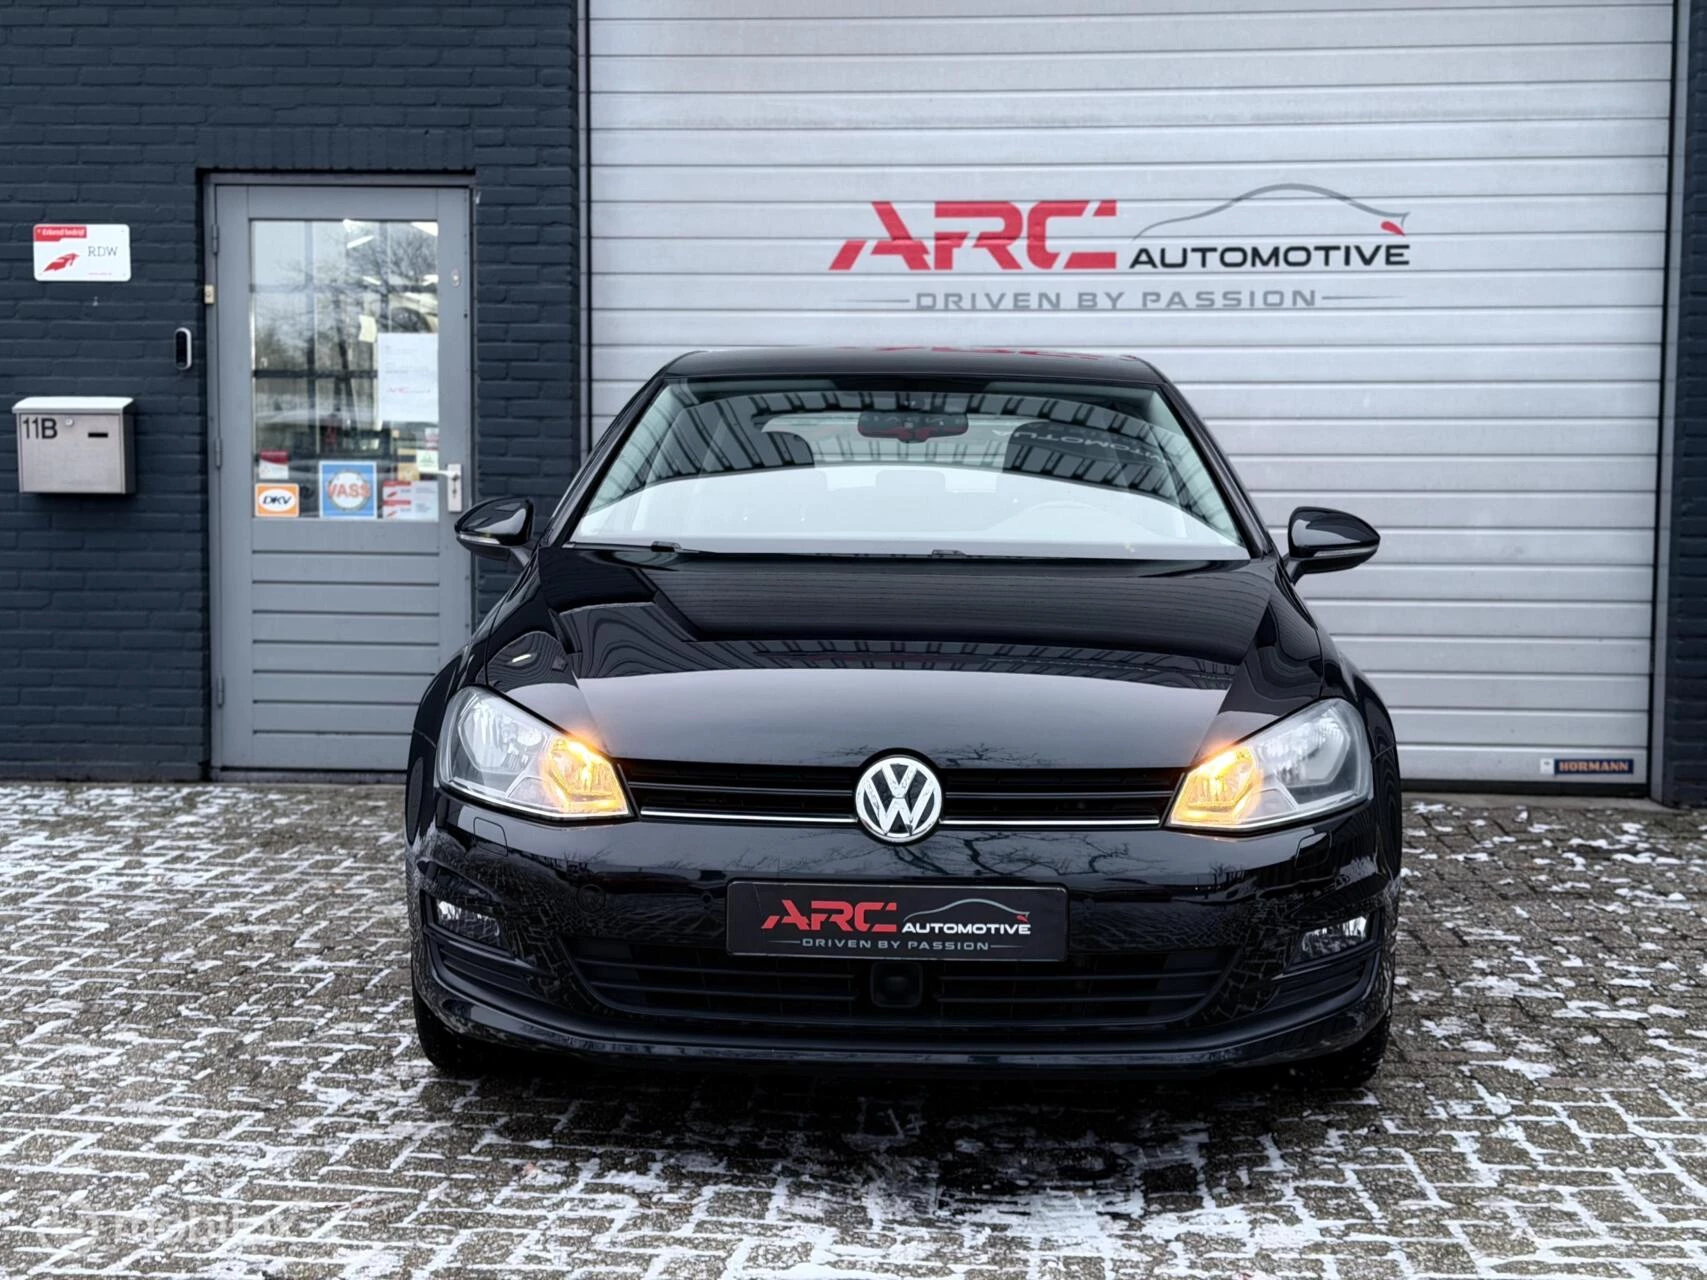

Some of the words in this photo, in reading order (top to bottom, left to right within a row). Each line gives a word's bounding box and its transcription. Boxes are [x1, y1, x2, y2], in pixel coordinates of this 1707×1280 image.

[828, 200, 1117, 270] ARC
[1130, 244, 1410, 270] AUTOMOTIVE
[88, 245, 118, 257] RDW
[916, 292, 1061, 310] DRIVEN
[1077, 291, 1125, 310] BY
[1142, 290, 1316, 309] PASSION
[22, 417, 57, 439] 11B
[262, 496, 292, 506] DKV
[761, 899, 897, 933] ARC
[902, 922, 1031, 935] AUTOMOTIVE
[802, 938, 871, 949] DRIVEN
[878, 940, 900, 949] BY
[908, 941, 989, 951] PASSION
